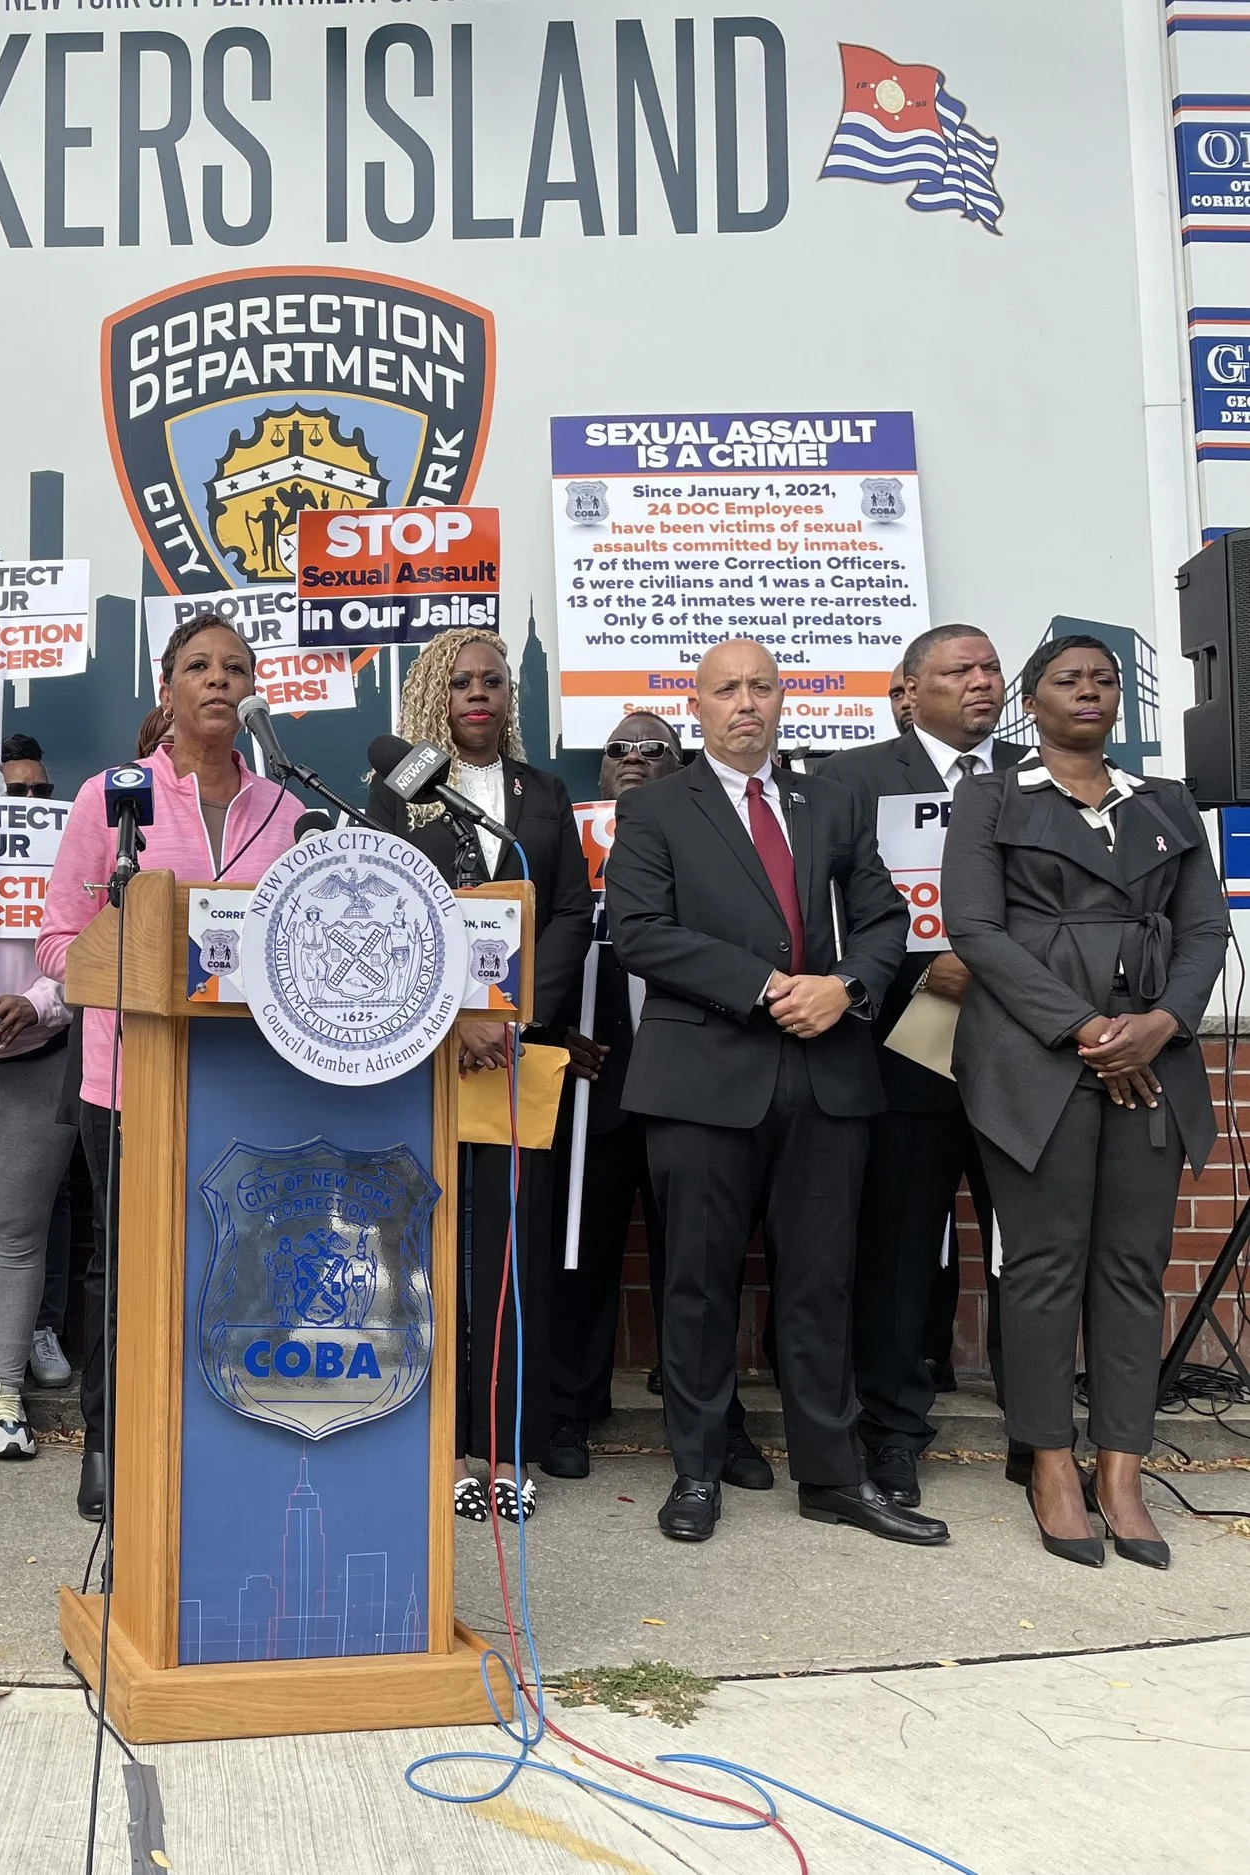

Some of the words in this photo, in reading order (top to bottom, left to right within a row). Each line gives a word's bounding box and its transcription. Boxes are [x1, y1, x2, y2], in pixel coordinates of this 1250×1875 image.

[325, 16, 791, 245] ISLAND
[129, 293, 465, 373] CORRECTION
[128, 341, 466, 420] DEPARTMENT
[585, 420, 719, 447] SEXUAL
[724, 419, 878, 444] ASSAULT
[637, 444, 670, 469] IS
[675, 445, 703, 469] A
[708, 443, 829, 468] CRIME!
[632, 484, 683, 499] Since
[687, 484, 761, 500] January
[765, 484, 781, 499] 1,
[784, 483, 837, 499] 2021,
[574, 510, 601, 518] COBA
[647, 503, 671, 516] 24
[677, 503, 720, 516] DOC
[725, 502, 824, 518] Employees
[870, 507, 897, 515] COBA
[143, 481, 211, 576] CITY
[326, 512, 473, 558] STOP
[611, 520, 655, 535] have
[659, 520, 704, 534] been
[709, 520, 776, 534] victims
[780, 520, 800, 534] of
[804, 520, 863, 534] sexual
[592, 539, 668, 553] assaults
[672, 538, 771, 553] committed
[777, 538, 800, 555] by
[804, 538, 884, 552] inmates.
[302, 562, 390, 588] Sexual
[395, 560, 497, 585] Assault
[573, 558, 594, 571] 17
[598, 557, 618, 571] of
[621, 557, 667, 571] them
[671, 560, 718, 571] were
[724, 556, 822, 571] Correction
[826, 556, 907, 571] Officers.
[572, 577, 584, 590] 6
[588, 579, 635, 590] were
[639, 576, 715, 590] civilians
[718, 576, 753, 590] and
[758, 576, 768, 589] 1
[773, 579, 810, 590] was
[814, 579, 826, 589] a
[830, 576, 910, 592] Captain.
[174, 591, 297, 625] PROTEC
[567, 595, 588, 608] 13
[593, 595, 612, 608] of
[616, 595, 647, 608] the
[651, 595, 676, 607] 24
[681, 595, 756, 608] inmates
[759, 597, 806, 607] were
[810, 594, 917, 608] re-arrested.
[302, 602, 333, 631] in
[339, 598, 406, 630] Our
[410, 595, 497, 628] Jails!
[603, 613, 647, 629] Only
[651, 613, 664, 626] 6
[669, 613, 688, 626] of
[692, 613, 723, 626] the
[728, 613, 787, 626] sexual
[792, 613, 882, 629] predators
[235, 619, 283, 644] UR
[586, 632, 625, 645] who
[629, 631, 730, 645] committed
[791, 631, 853, 645] crimes
[857, 631, 903, 645] have
[648, 674, 697, 690] Enou
[779, 674, 846, 694] ough!
[796, 703, 830, 717] Our
[834, 703, 874, 717] Jails
[777, 724, 876, 741] SECUTED!
[396, 759, 426, 791] NEWS
[251, 871, 283, 918] NEW
[282, 836, 334, 874] YORK
[338, 833, 386, 853] CITY
[389, 843, 457, 918] COUNCIL
[480, 920, 501, 930] INC.
[207, 960, 232, 970] COBA
[477, 970, 501, 978] COBA
[303, 1011, 379, 1043] CIVITATIS
[380, 1007, 417, 1036] NOVI
[341, 1011, 374, 1023] 1625
[262, 1004, 304, 1055] Council
[302, 1045, 361, 1074] Member
[365, 1037, 426, 1074] Adrienne
[426, 992, 455, 1041] Adams
[244, 1180, 278, 1207] CITY
[283, 1173, 304, 1191] OF
[311, 1172, 350, 1189] NEW
[354, 1179, 397, 1210] YORK
[271, 1196, 371, 1223] CORRECTION
[243, 1340, 383, 1379] COBA
